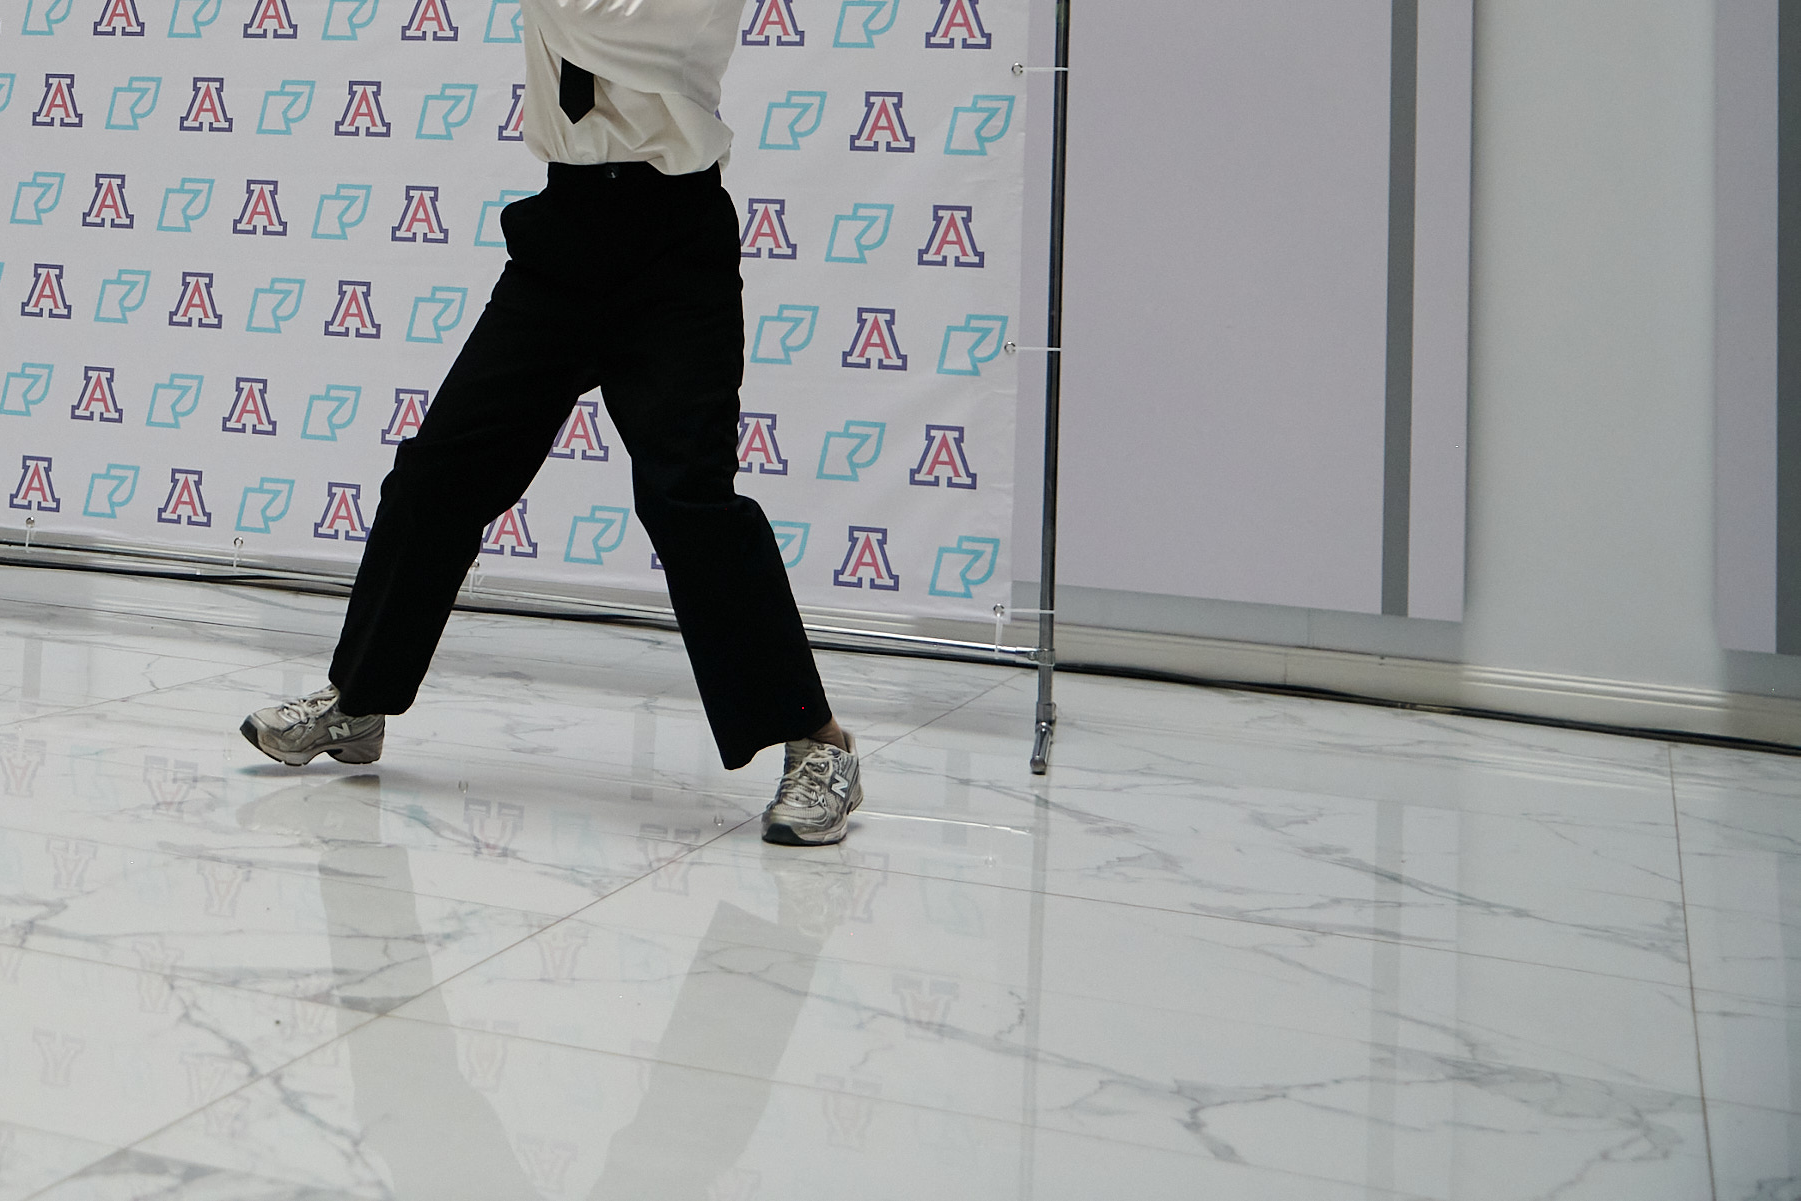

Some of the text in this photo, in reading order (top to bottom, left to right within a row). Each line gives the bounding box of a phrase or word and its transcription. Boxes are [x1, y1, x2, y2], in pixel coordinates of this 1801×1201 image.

[33, 74, 82, 127] A
[180, 77, 232, 131] A
[335, 81, 391, 136] A
[850, 91, 914, 152] A
[83, 174, 133, 228] A
[233, 180, 287, 235] A
[391, 186, 448, 243] A
[741, 198, 796, 259] A
[918, 205, 984, 267] A
[21, 264, 71, 318] A
[169, 272, 222, 328] A
[325, 280, 380, 338] A
[842, 307, 907, 370] A
[71, 366, 123, 422] A
[222, 377, 276, 435] A
[10, 456, 60, 512] A
[910, 424, 976, 489] A
[158, 468, 211, 526] A
[314, 482, 371, 542] A
[833, 526, 898, 590] A
[328, 722, 351, 740] N
[831, 773, 848, 798] N
